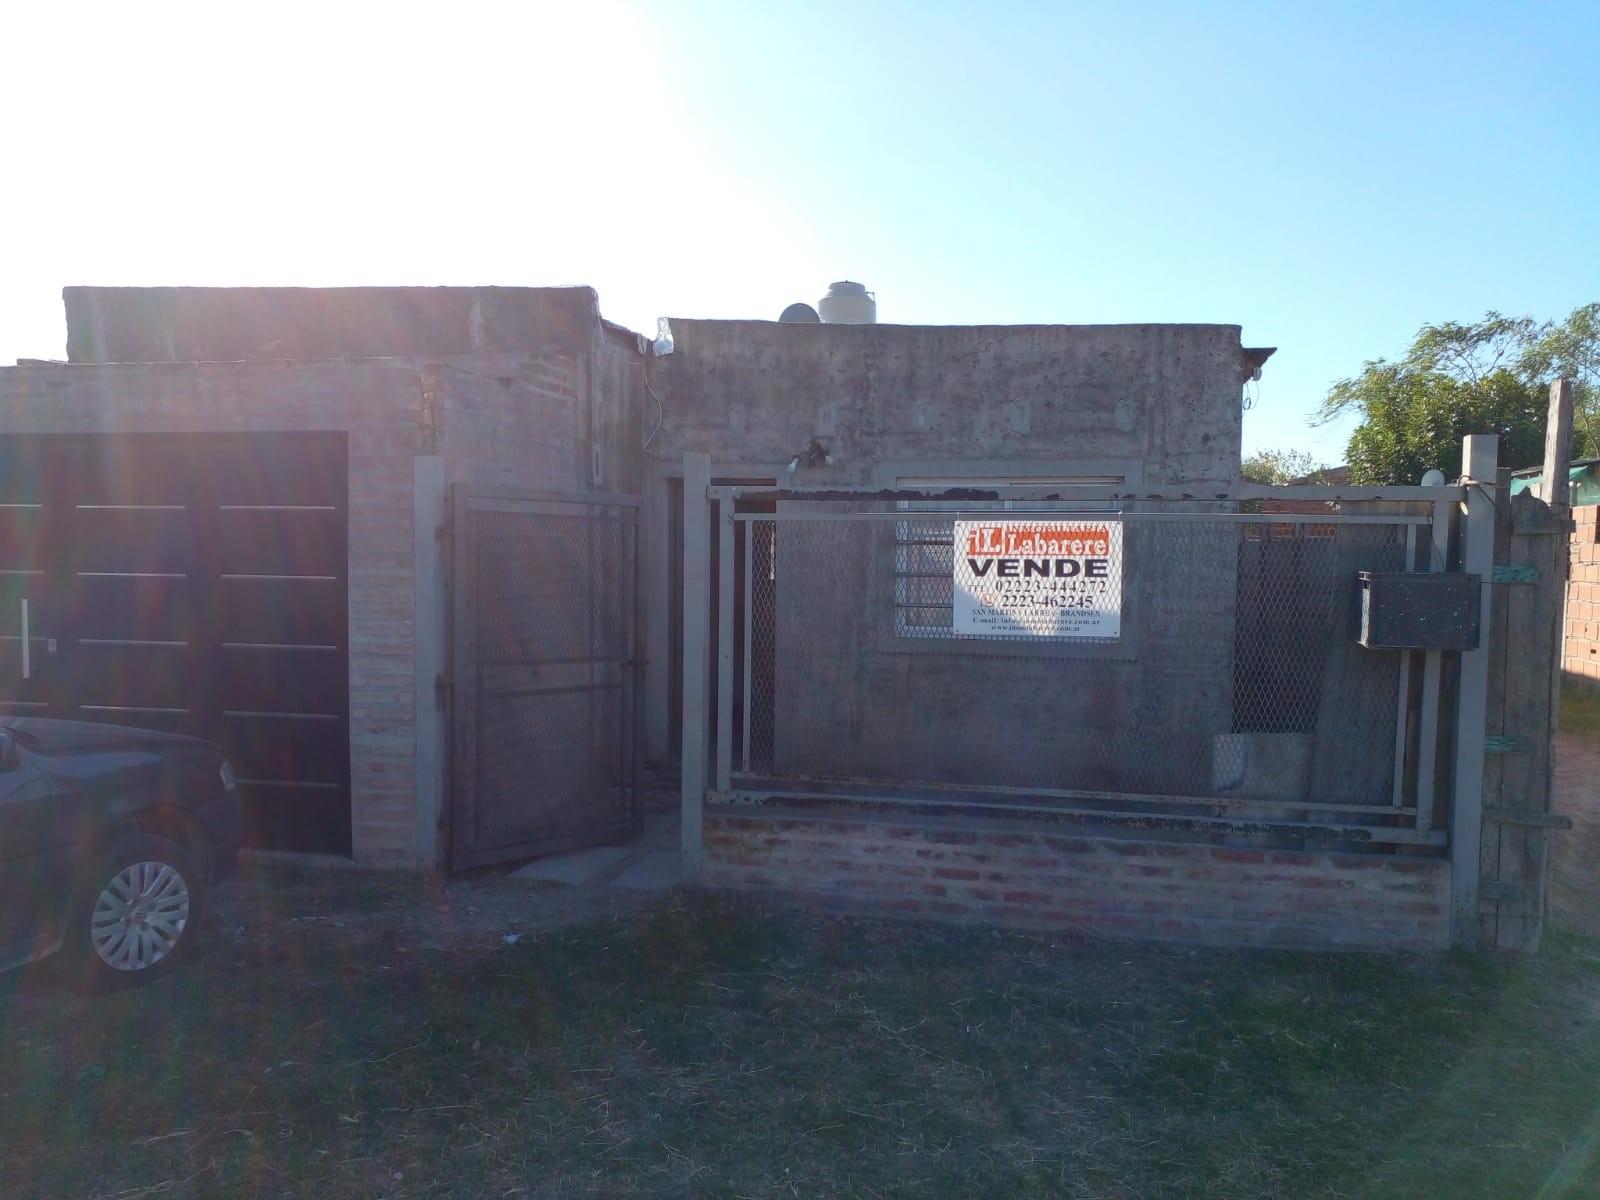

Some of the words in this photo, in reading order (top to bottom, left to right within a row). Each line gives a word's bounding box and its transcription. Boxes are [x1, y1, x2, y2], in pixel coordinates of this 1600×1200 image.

[1007, 533, 1107, 555] Labarere
[967, 558, 1108, 577] VENDE
[995, 580, 1106, 593] 02223-444272
[1002, 594, 1094, 608] 2223-462245
[1060, 609, 1101, 617] BRANDSEN
